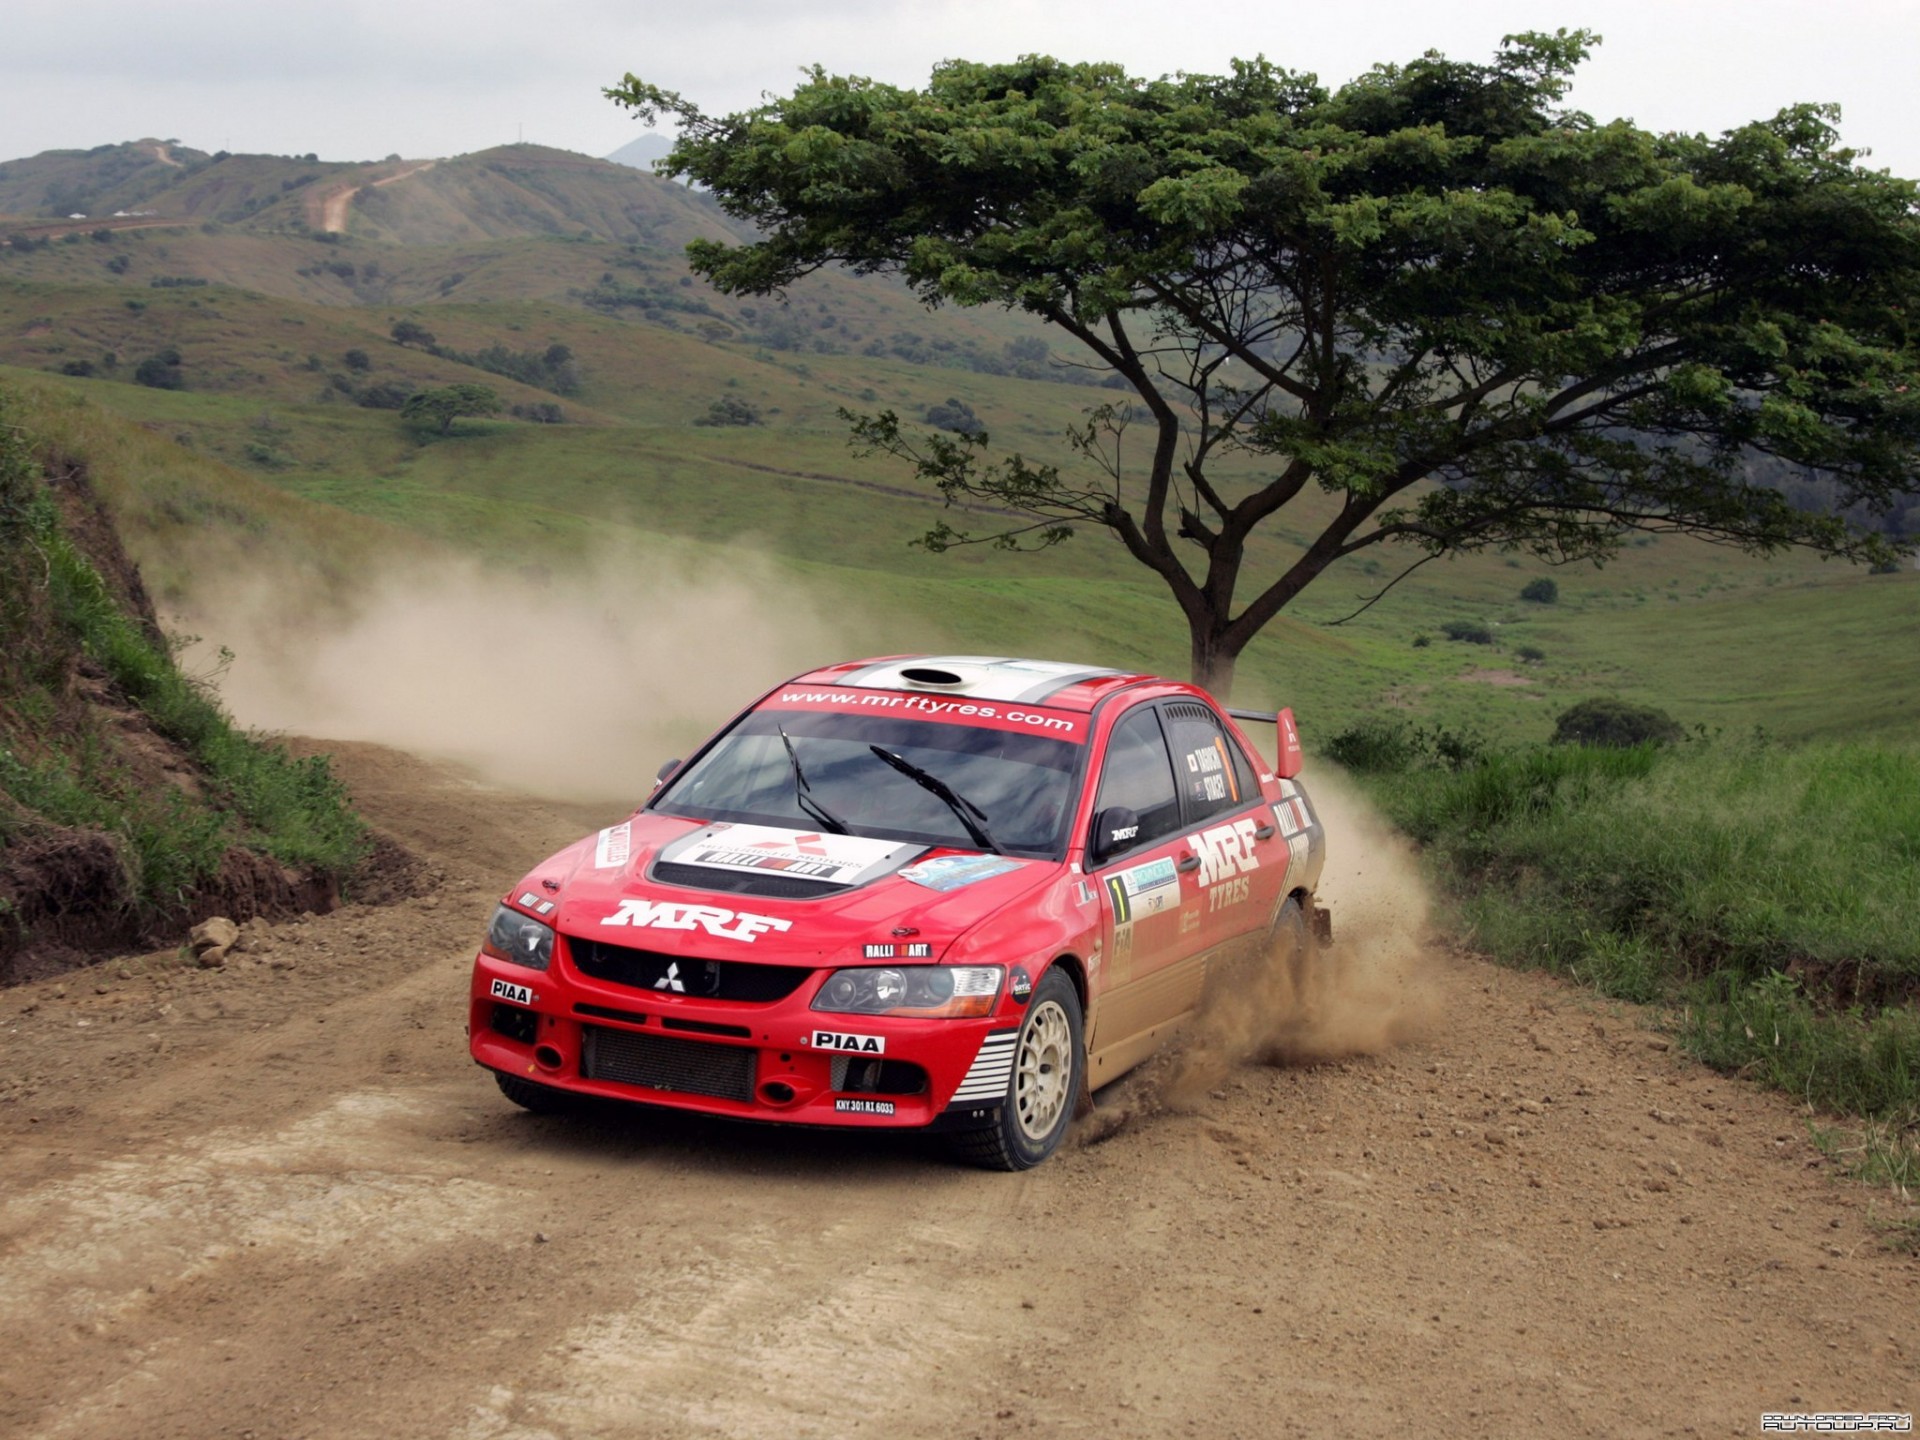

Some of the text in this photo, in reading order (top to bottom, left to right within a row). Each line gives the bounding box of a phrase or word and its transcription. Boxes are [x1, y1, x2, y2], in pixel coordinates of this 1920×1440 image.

[781, 692, 1074, 731] www.mrftyres.com
[1111, 826, 1139, 841] MRF
[705, 851, 832, 876] RALLI ART
[1187, 818, 1260, 888] MRF
[1112, 878, 1126, 922] 1
[1209, 876, 1249, 913] TYRES
[600, 899, 793, 943] MRF
[866, 944, 928, 957] RALLI ART
[493, 981, 528, 1002] PIAA
[816, 1032, 880, 1052] PIAA
[836, 1100, 850, 1110] KNY
[851, 1101, 864, 1111] 301
[875, 1102, 894, 1114] 6033
